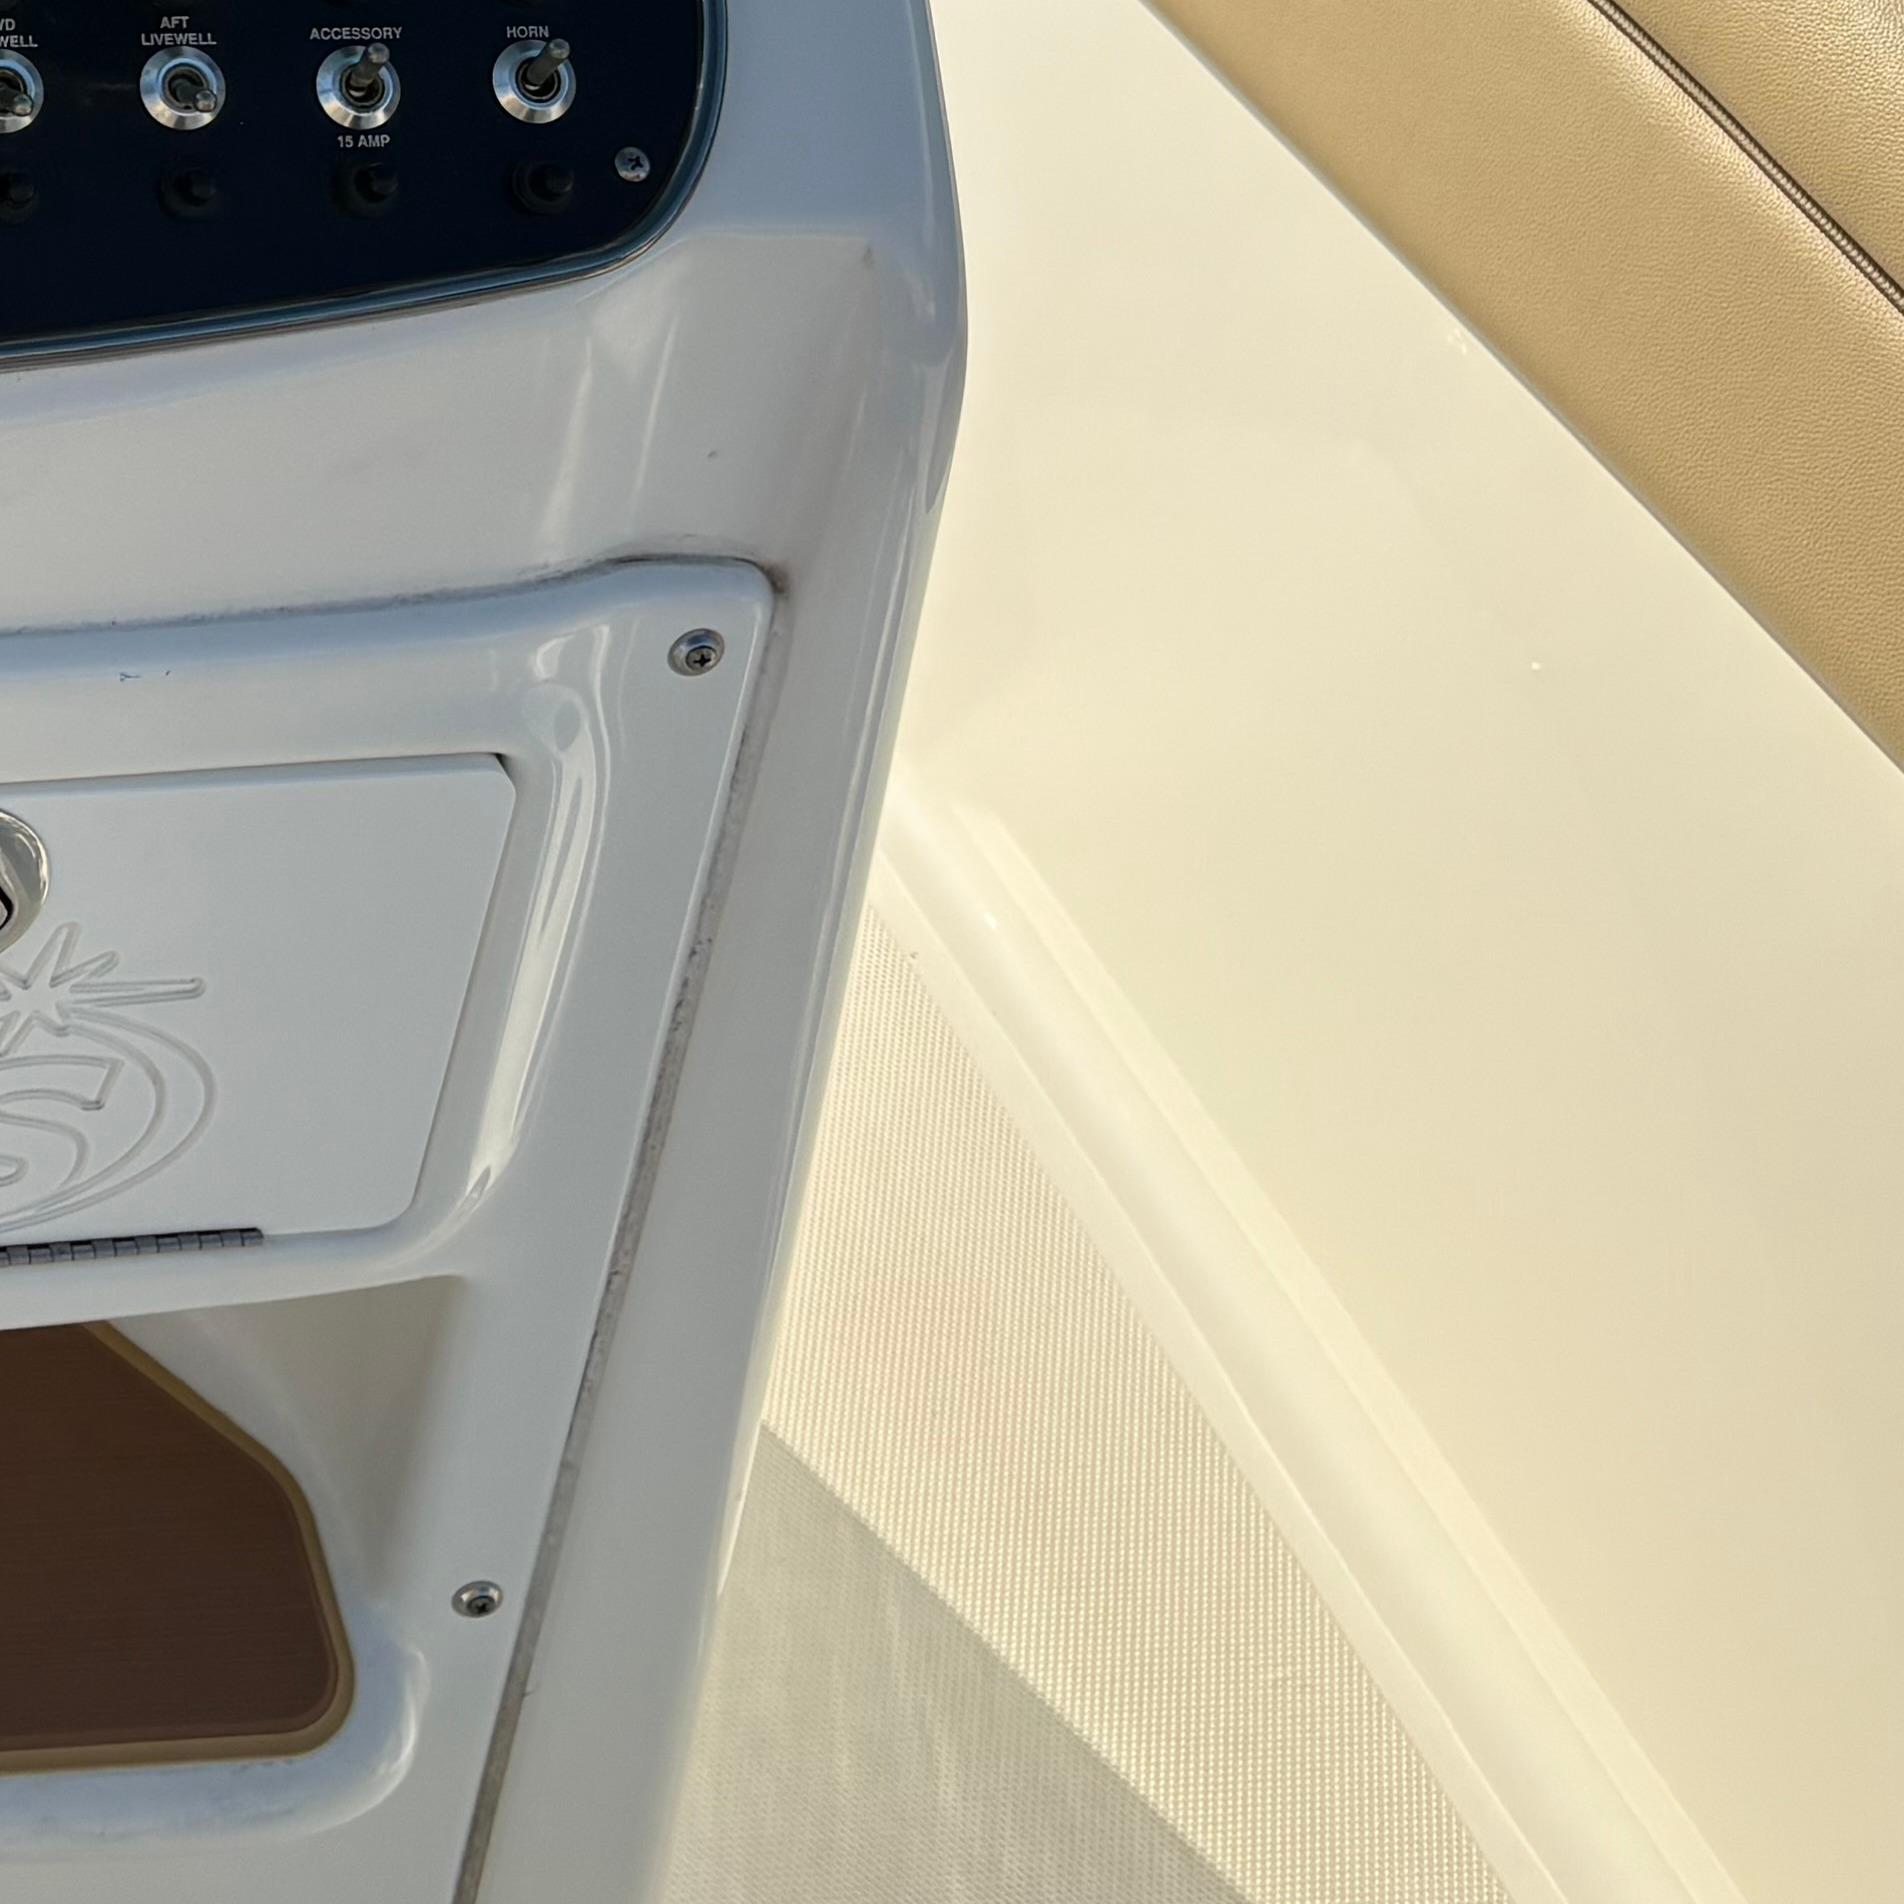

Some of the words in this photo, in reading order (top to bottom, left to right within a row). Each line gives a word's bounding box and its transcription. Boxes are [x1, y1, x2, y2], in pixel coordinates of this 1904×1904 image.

[160, 16, 190, 29] AFT
[310, 26, 403, 40] ACCESSORY
[507, 26, 550, 39] HORN
[142, 33, 217, 46] LIVEWELL
[338, 136, 353, 148] 15
[358, 134, 391, 148] AMP
